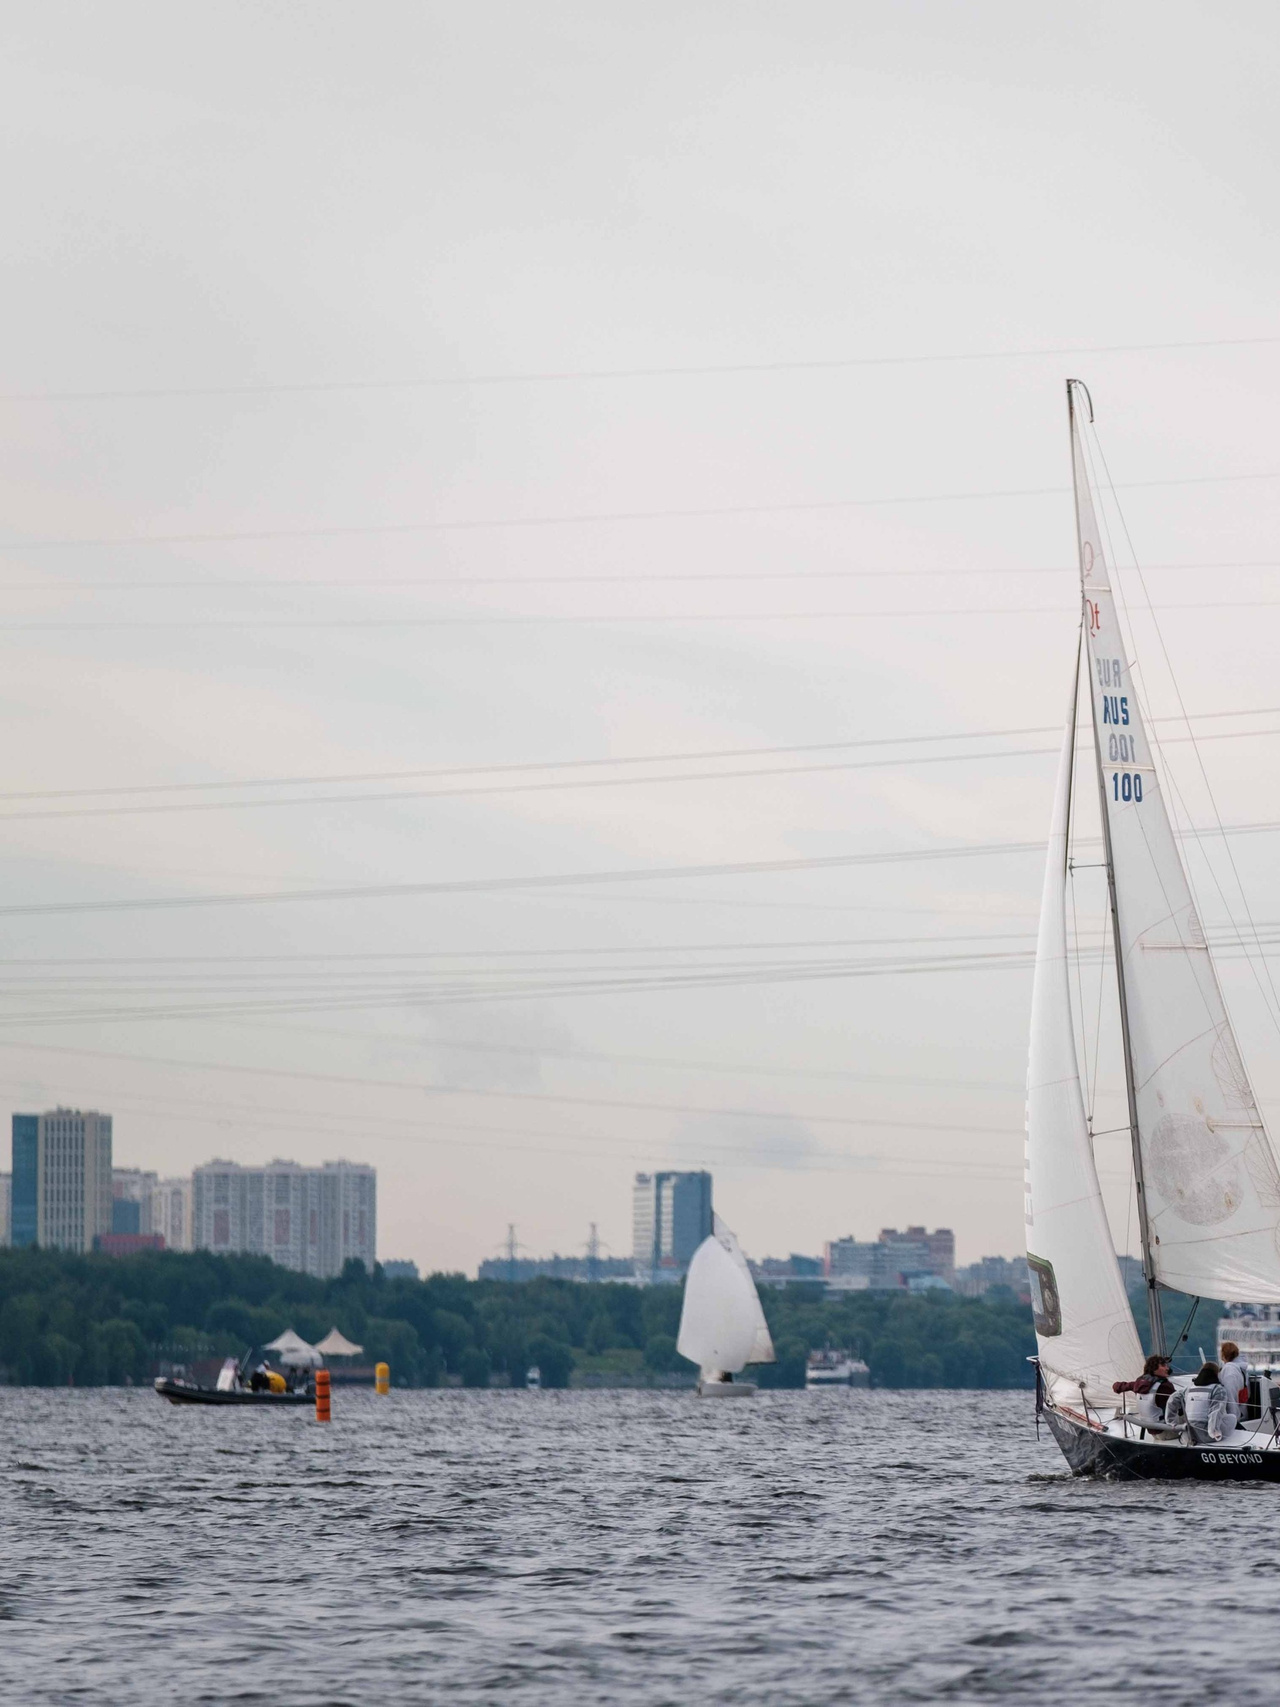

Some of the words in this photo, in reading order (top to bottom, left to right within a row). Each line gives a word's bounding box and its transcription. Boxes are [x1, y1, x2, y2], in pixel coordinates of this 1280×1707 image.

[1103, 695, 1129, 725] RUS
[1112, 772, 1143, 803] 100
[1201, 1453, 1216, 1463] GO
[1218, 1453, 1263, 1464] BEYOND
